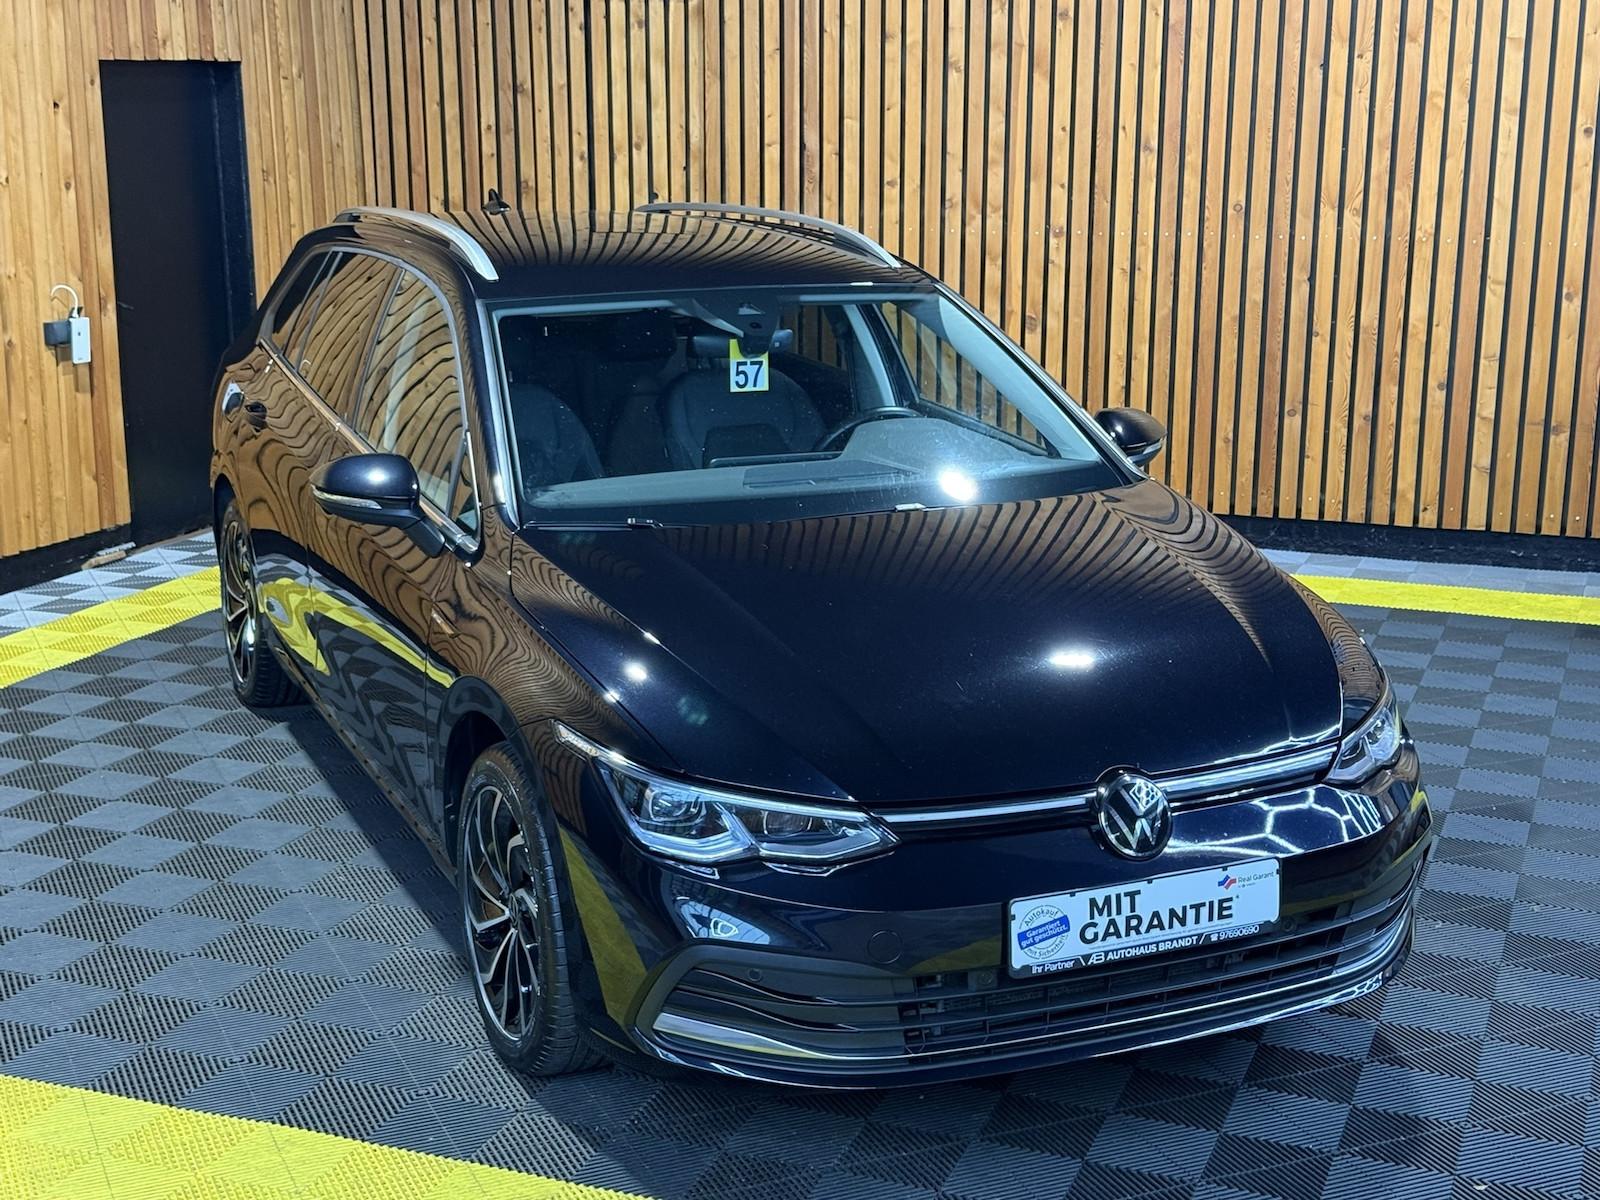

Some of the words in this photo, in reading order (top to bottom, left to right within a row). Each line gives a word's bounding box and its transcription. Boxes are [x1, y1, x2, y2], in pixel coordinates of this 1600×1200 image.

[735, 360, 764, 389] 57
[1238, 875, 1252, 884] Real
[1253, 871, 1274, 881] Garant
[1089, 889, 1141, 920] MIT
[1025, 907, 1059, 927] Autokauf
[1079, 896, 1234, 945] GARANTIE
[1026, 920, 1061, 938] Garantiert
[1021, 937, 1034, 948] gut
[1106, 943, 1157, 961] AUTOHAUS
[1158, 935, 1198, 951] BRANDT
[1032, 965, 1043, 974] Ihr
[1044, 960, 1075, 972] Partner
